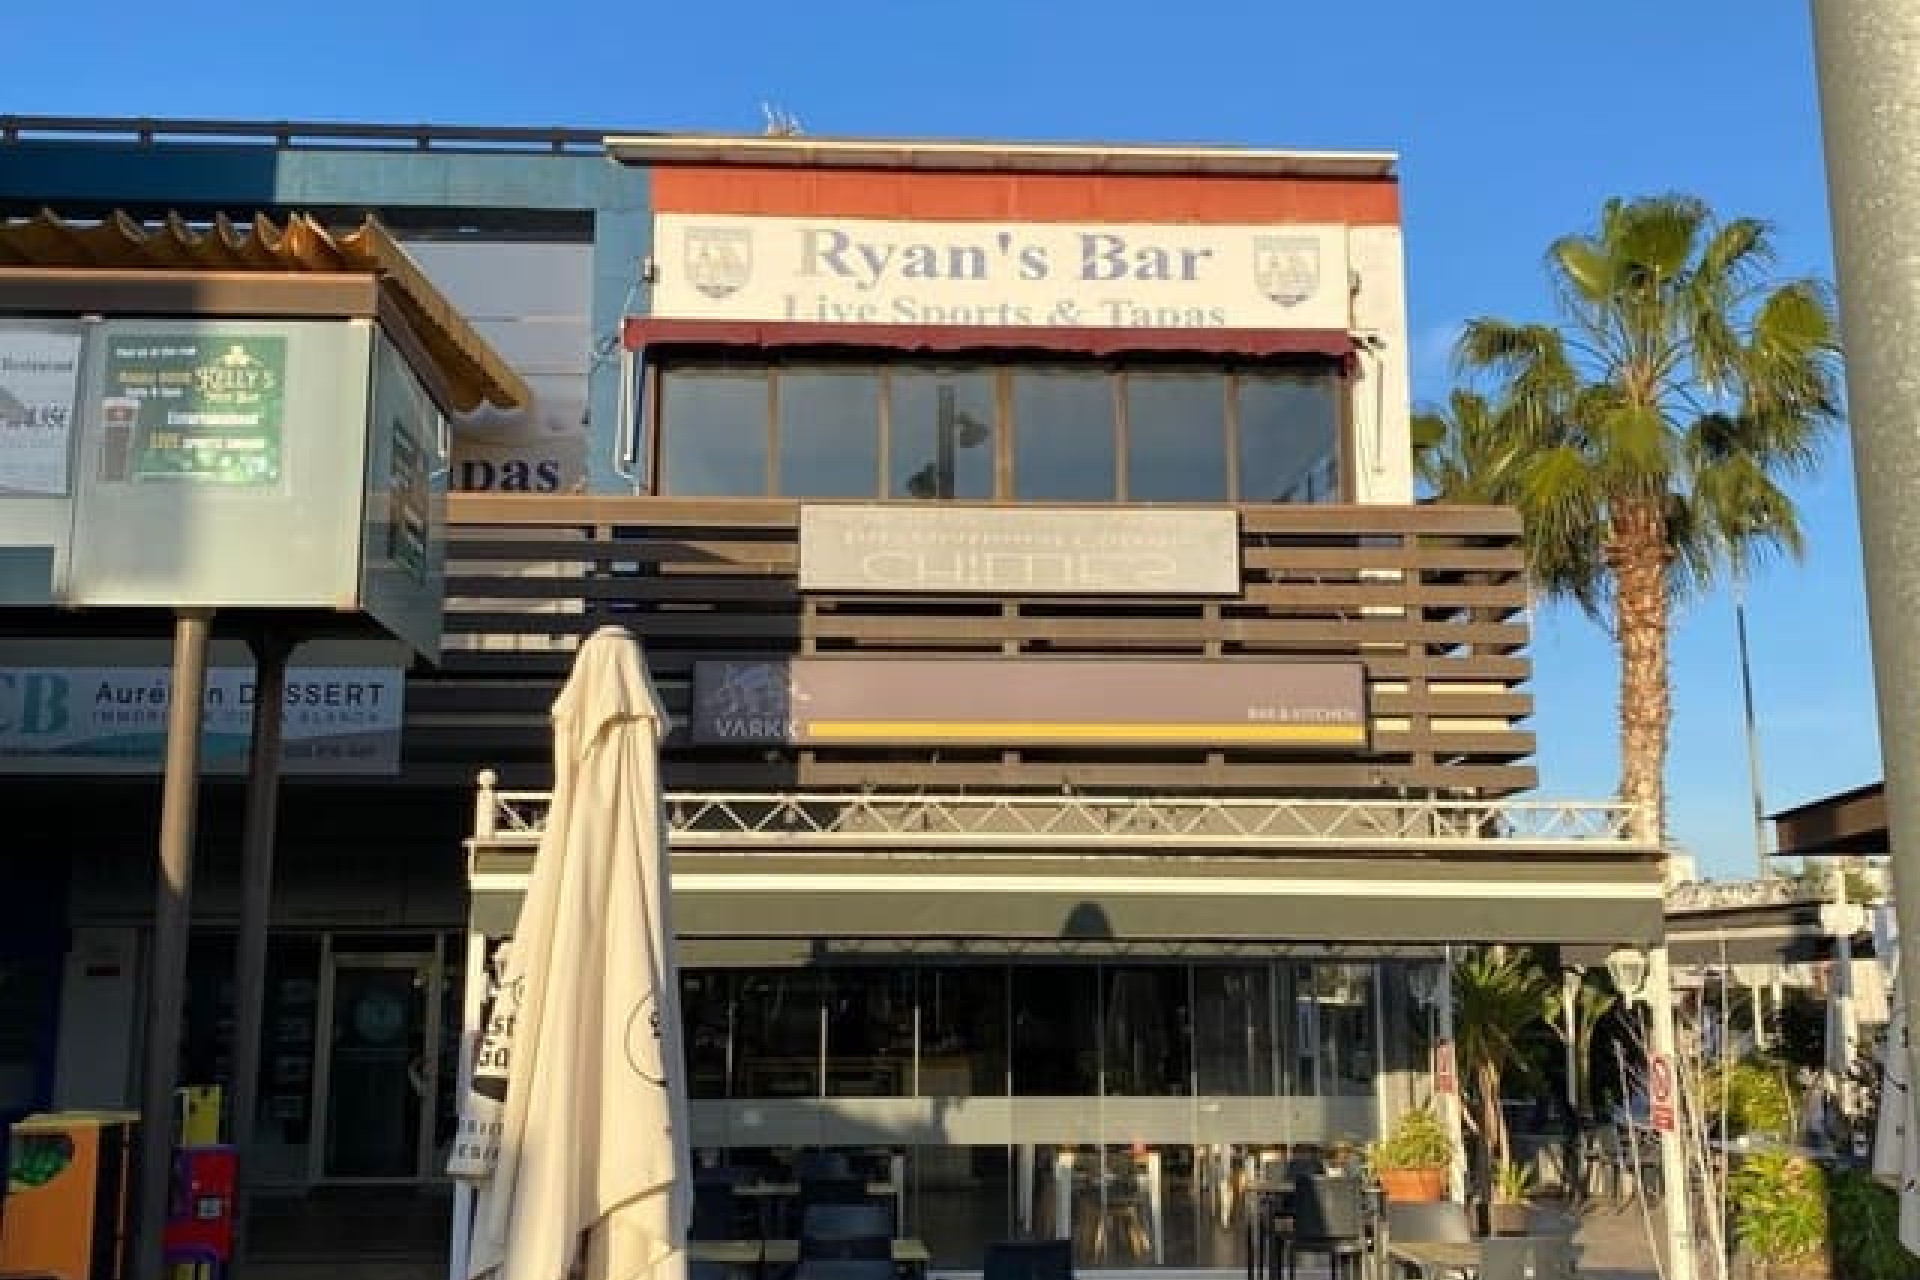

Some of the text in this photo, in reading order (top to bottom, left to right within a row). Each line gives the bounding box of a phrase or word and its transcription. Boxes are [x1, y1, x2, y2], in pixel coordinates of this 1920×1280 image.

[793, 229, 1213, 289] Ryan's Bar
[784, 294, 878, 324] Live
[891, 296, 1032, 326] Sports
[1102, 299, 1227, 328] Tapas
[95, 677, 385, 705] Aurén DSSERT
